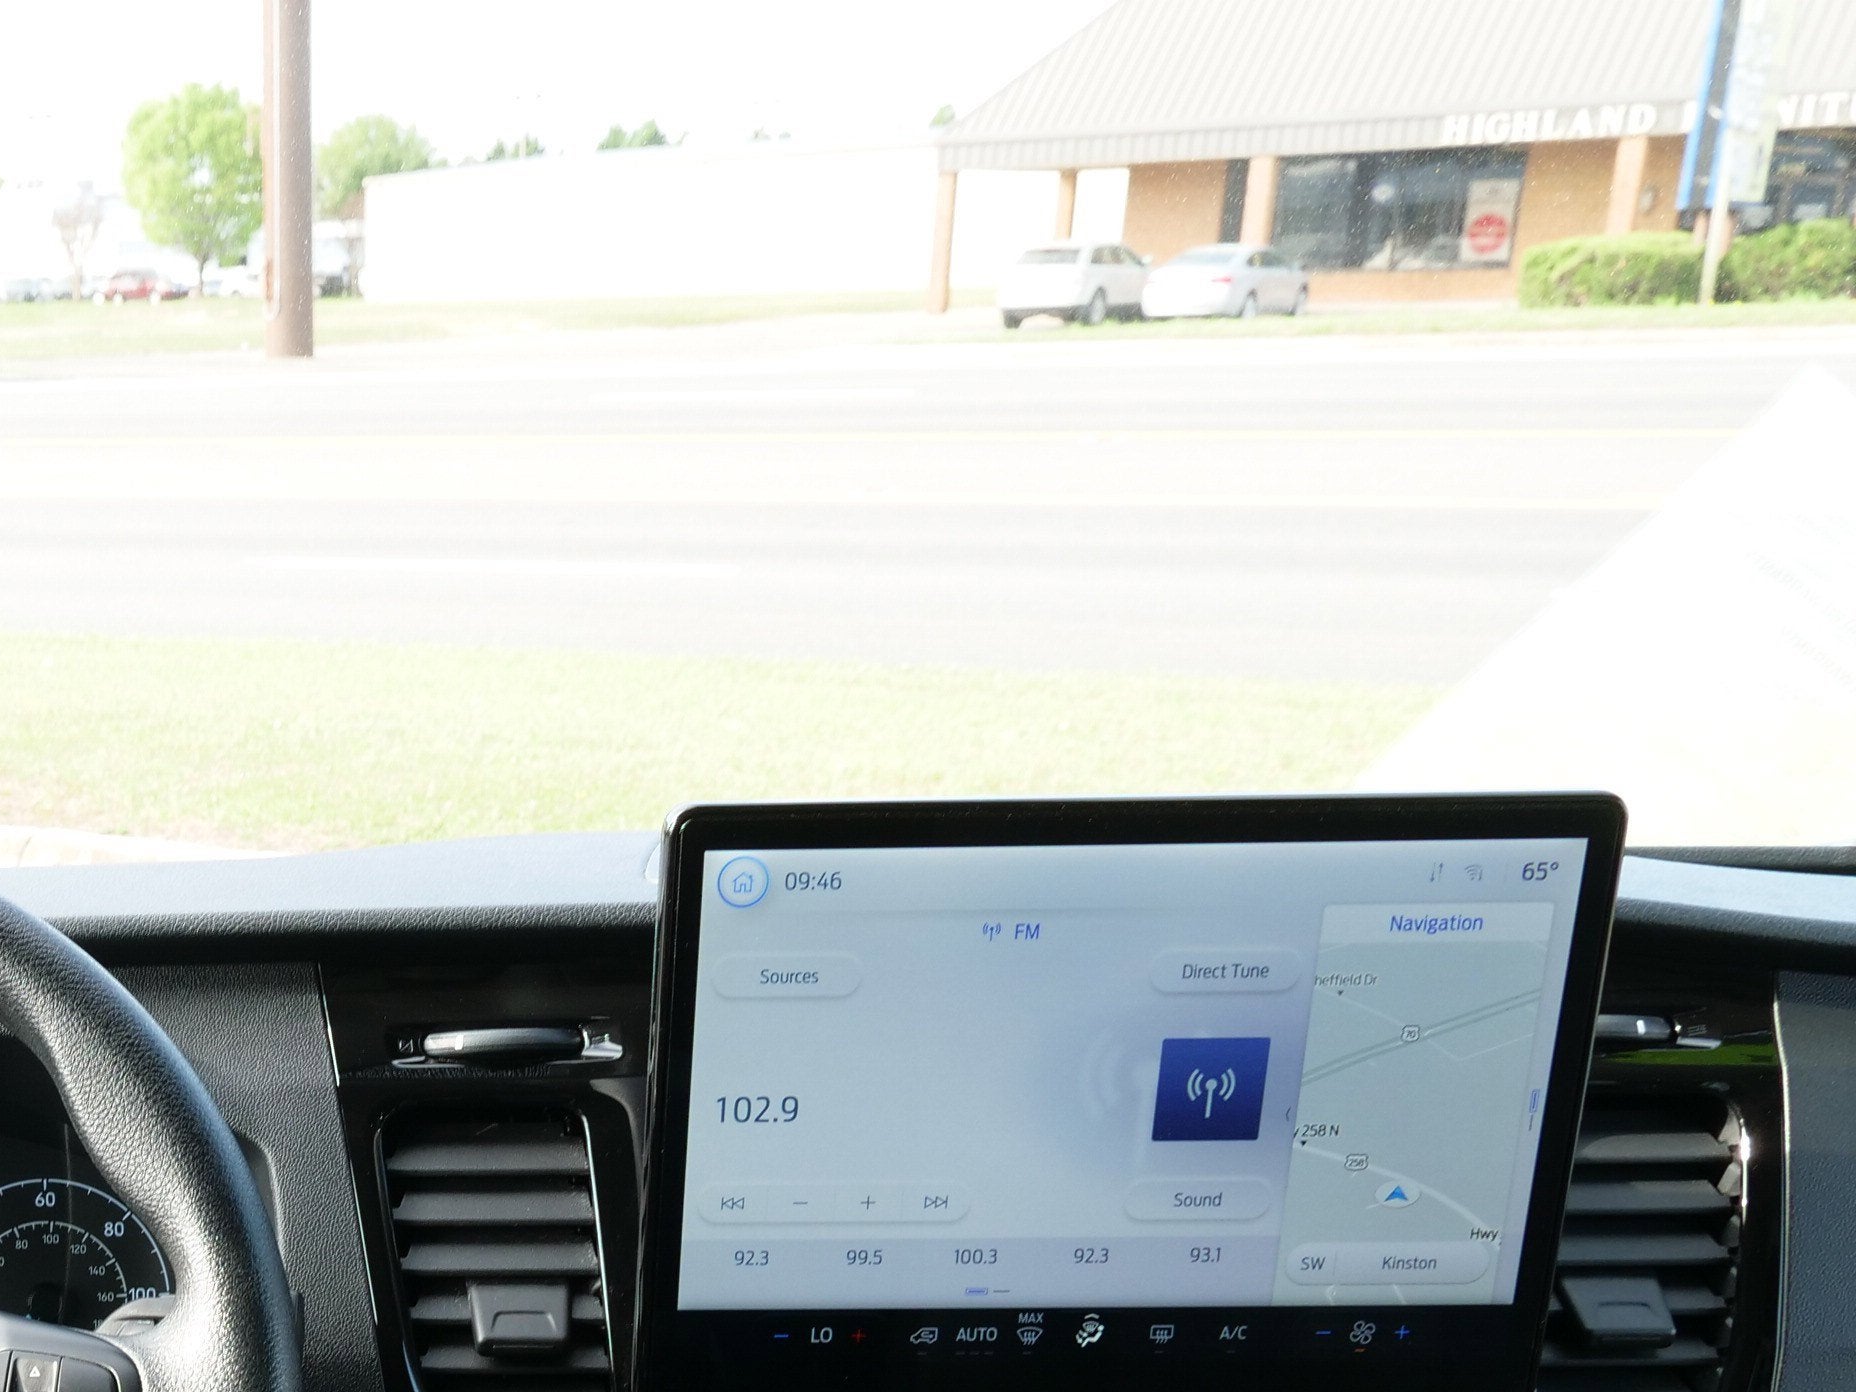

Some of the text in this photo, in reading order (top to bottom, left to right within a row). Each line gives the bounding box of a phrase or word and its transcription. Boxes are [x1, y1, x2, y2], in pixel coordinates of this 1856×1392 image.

[1440, 104, 1657, 144] HIGHLAND
[1521, 861, 1559, 881] 65°
[784, 871, 842, 891] 09:46
[1014, 923, 1041, 940] FM
[1389, 914, 1484, 934] Navigation
[759, 968, 819, 985] Sources
[1182, 963, 1270, 980] Direct Tune
[716, 1095, 800, 1124] 102.9
[1301, 1124, 1340, 1138] 258 N
[34, 1191, 56, 1208] 60
[1173, 1192, 1222, 1208] Sound
[103, 1220, 125, 1237] 80
[1470, 1228, 1498, 1242] Hwy
[15, 1239, 29, 1250] 80
[42, 1233, 60, 1245] 100
[70, 1244, 87, 1255] 120
[846, 1249, 883, 1266] 99.5
[954, 1248, 998, 1265] 100.3
[1073, 1248, 1110, 1265] 92.3
[1189, 1247, 1222, 1263] 93.1
[733, 1250, 770, 1267] 92.3
[1300, 1257, 1326, 1271] SW
[1381, 1256, 1438, 1271] Kinston
[88, 1265, 106, 1276] 140
[96, 1291, 115, 1302] 160
[1017, 1312, 1045, 1324] MAX
[810, 1326, 833, 1344] LO
[955, 1326, 998, 1342] AUTO
[1219, 1325, 1248, 1341] A/C
